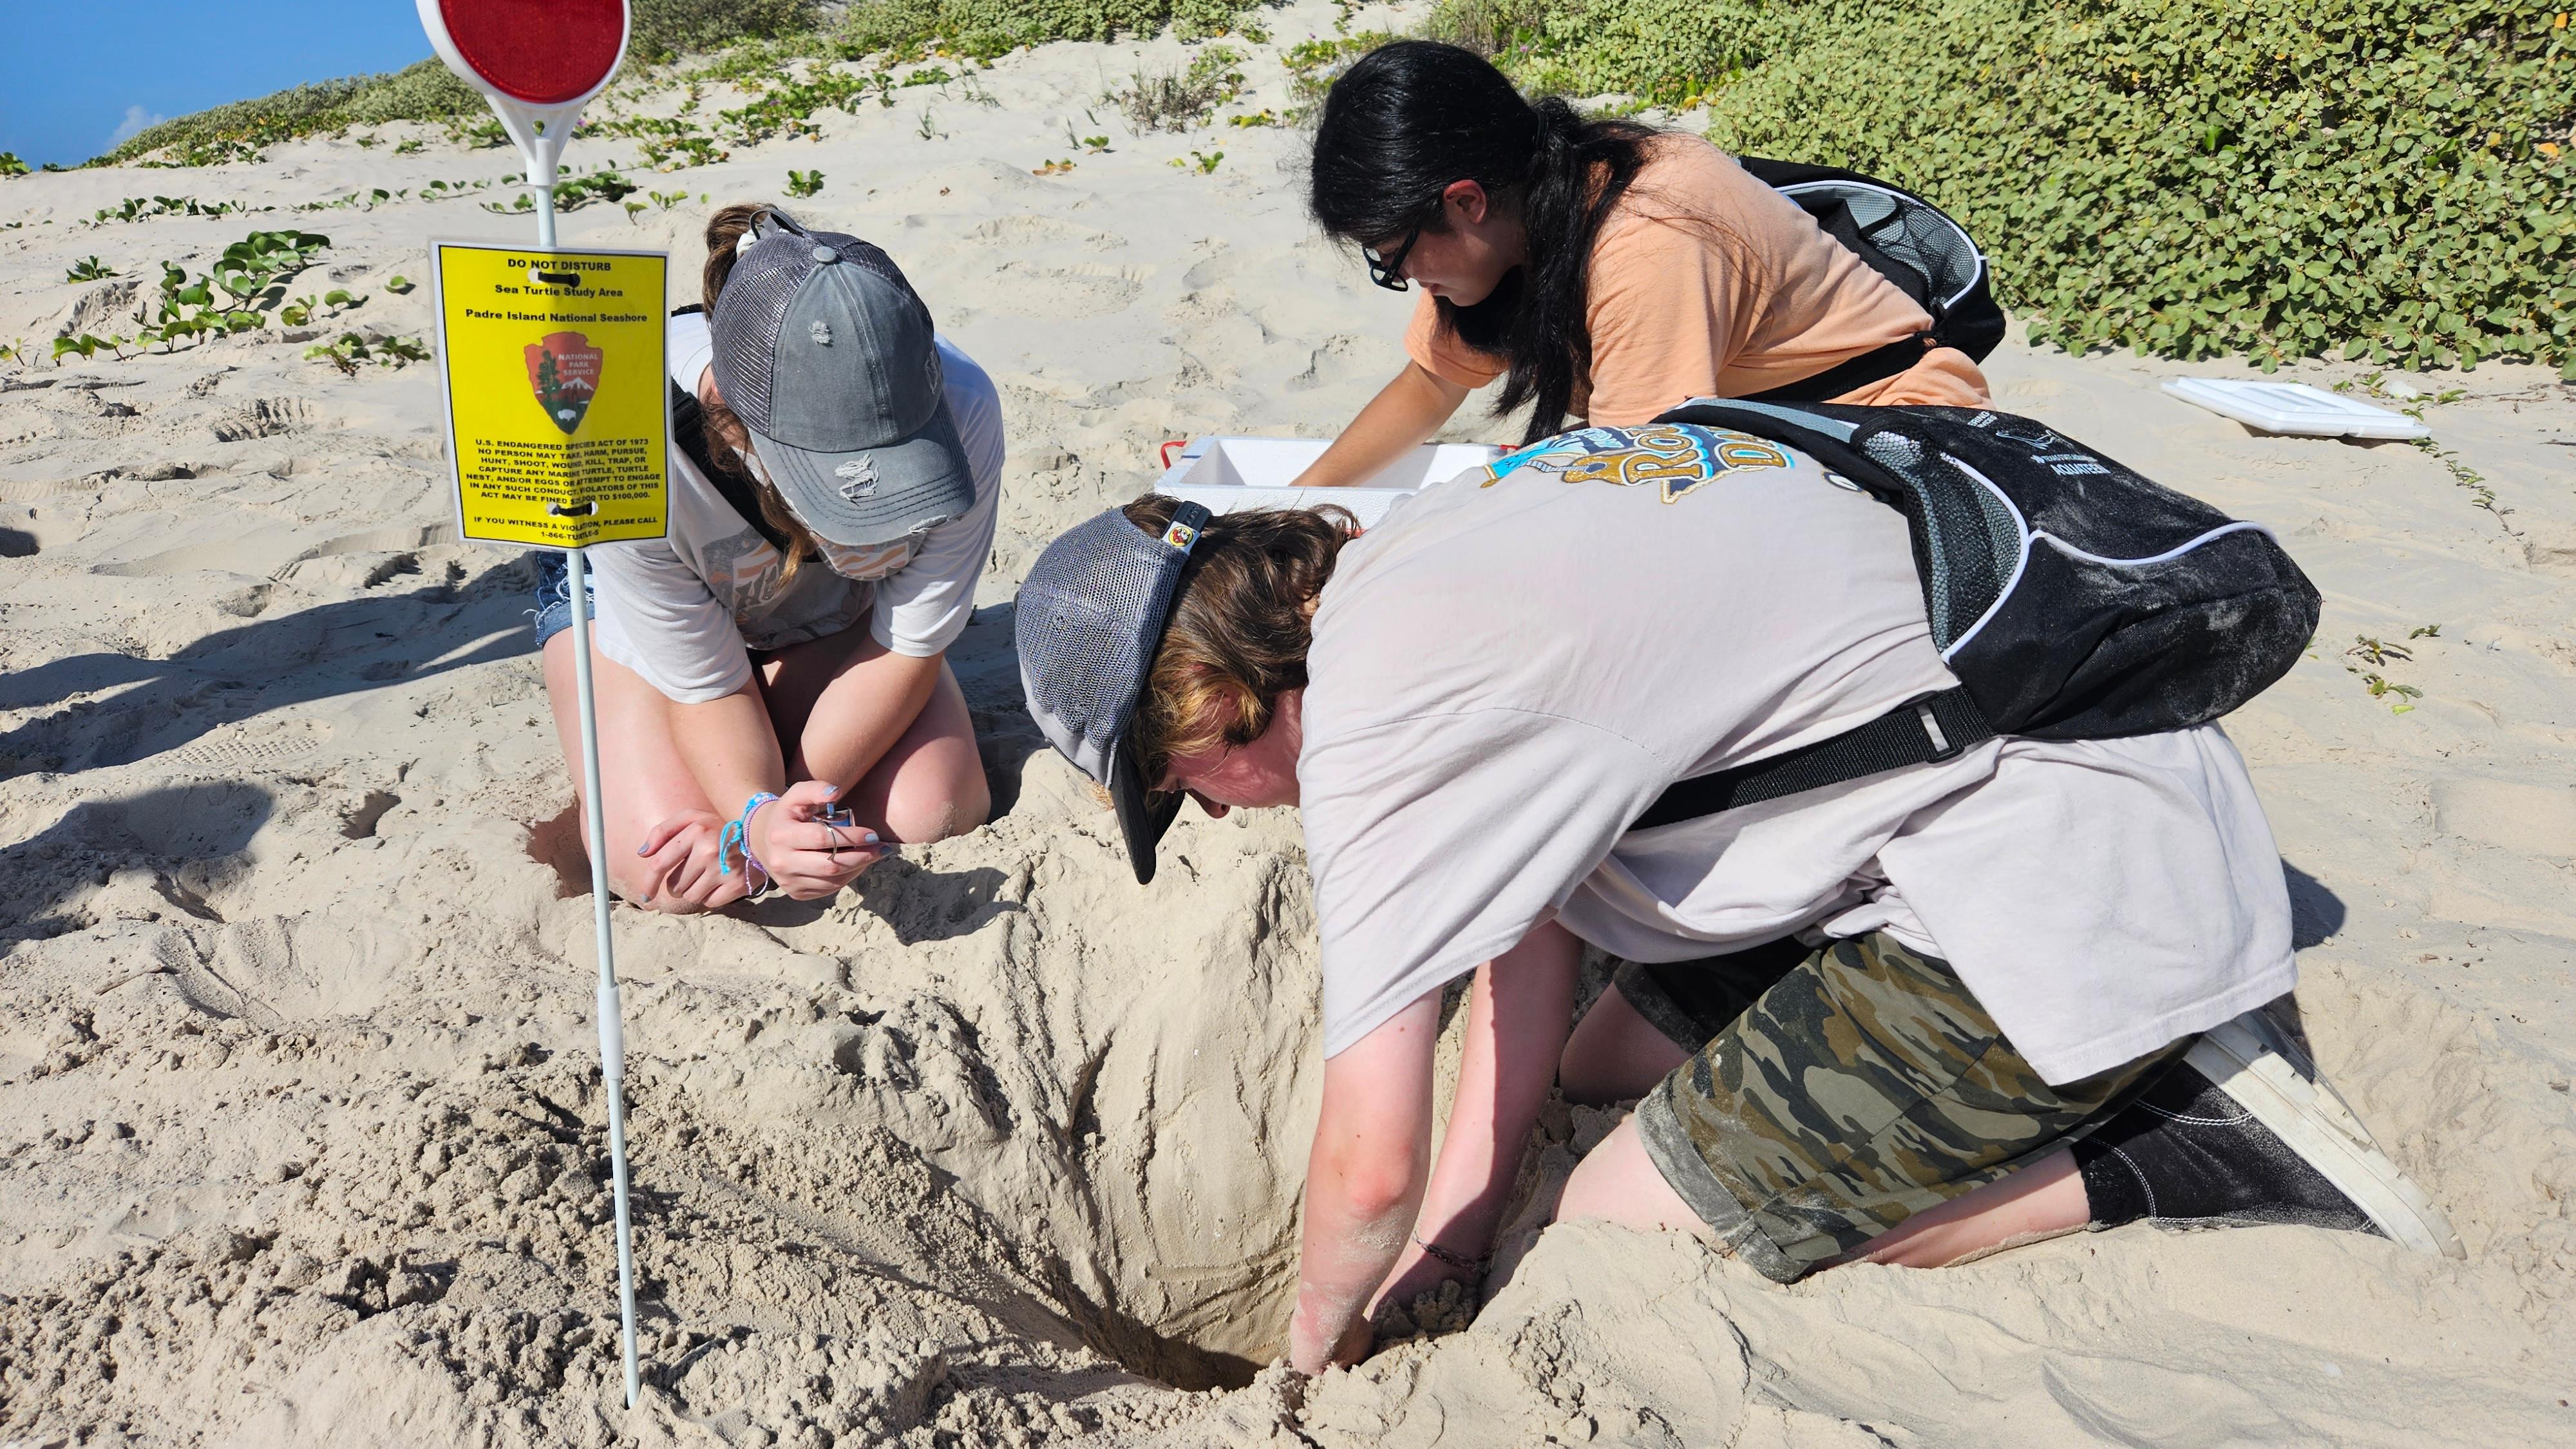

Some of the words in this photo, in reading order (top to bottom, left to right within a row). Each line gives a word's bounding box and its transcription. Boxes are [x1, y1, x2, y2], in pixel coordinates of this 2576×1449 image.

[508, 259, 526, 268] DO
[531, 260, 557, 269] NOT
[561, 261, 611, 271] DISTURB
[495, 285, 518, 294] Sea
[523, 286, 560, 296] Turtle
[564, 287, 595, 298] Study
[466, 309, 502, 319] Padre
[507, 311, 545, 321] Island
[550, 313, 596, 322] National
[600, 314, 647, 322] Seashore
[497, 440, 562, 450] ENDANGERED
[565, 440, 596, 450] SPECIES
[480, 457, 510, 466] HUNT,
[514, 460, 549, 468] SHOOT,
[479, 466, 522, 475] CAPTURE
[2050, 463, 2112, 475] AQUATEEN
[576, 477, 611, 485] ATTEMPT
[612, 492, 650, 500] $100,000.
[507, 519, 549, 529] WITNESS
